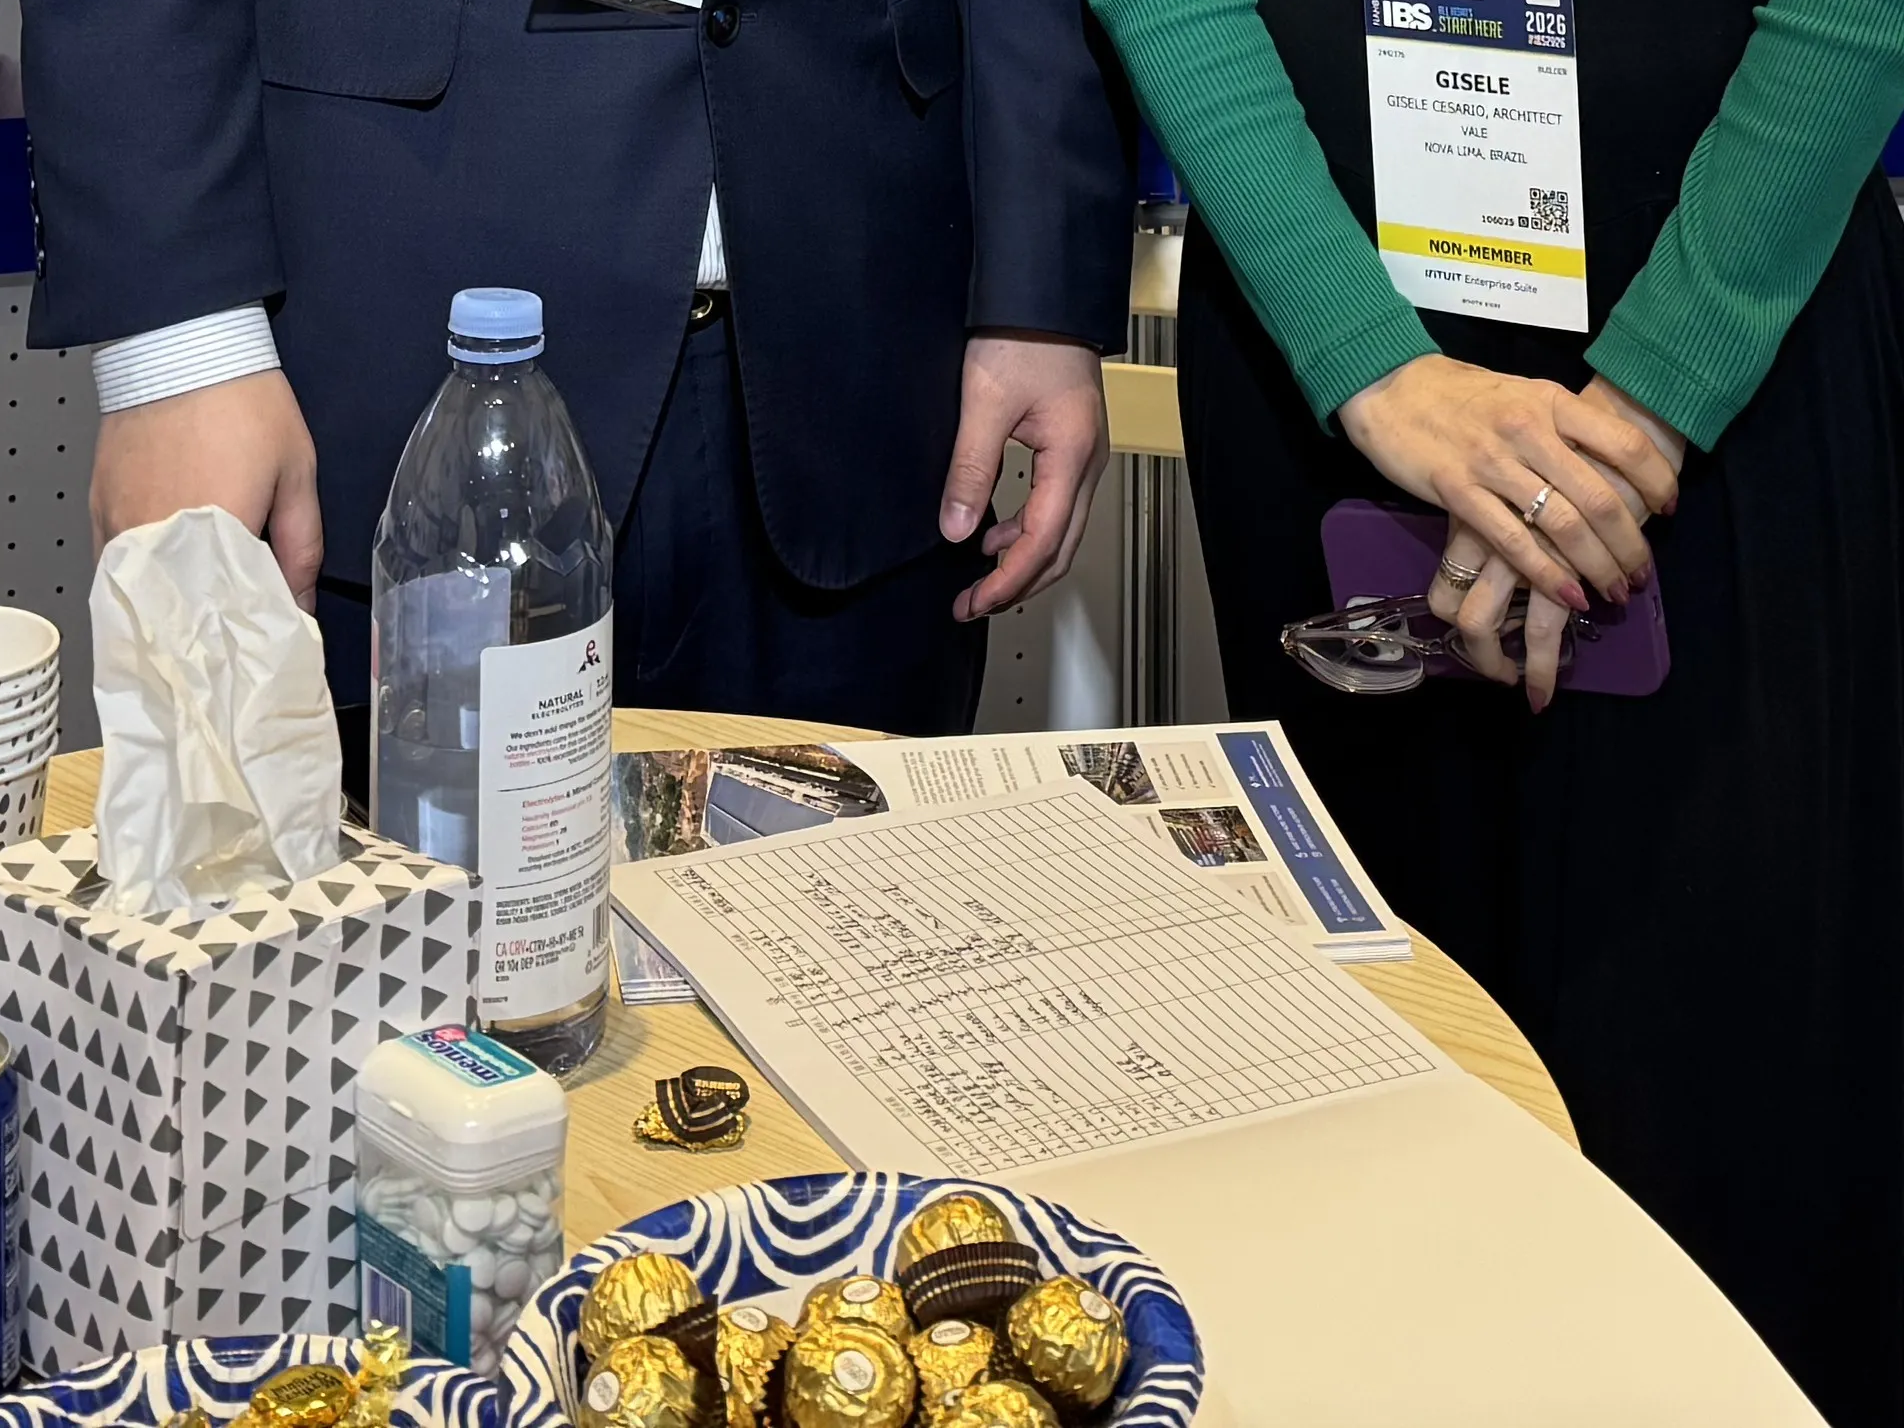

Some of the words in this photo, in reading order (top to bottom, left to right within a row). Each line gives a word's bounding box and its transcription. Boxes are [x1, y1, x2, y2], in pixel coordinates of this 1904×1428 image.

[1383, 1, 1433, 31] IBS
[1438, 15, 1473, 35] START
[1474, 19, 1504, 39] HERE
[1525, 11, 1566, 36] 2026
[1435, 70, 1510, 95] GISELE
[1387, 95, 1428, 112] GISELE
[1432, 100, 1489, 119] CESARIO,
[1493, 107, 1563, 126] ARCHITECT
[1461, 126, 1488, 139] VALE
[1424, 141, 1454, 156] NOVA
[1490, 150, 1528, 165] BRAZIL
[1429, 238, 1533, 266] NON-MEMBER
[1464, 274, 1513, 293] Enterprise
[1514, 280, 1538, 294] Suite
[538, 689, 583, 710] NATURAL
[496, 942, 507, 957] CA
[521, 955, 534, 970] DEP
[410, 1030, 504, 1083] mentos
